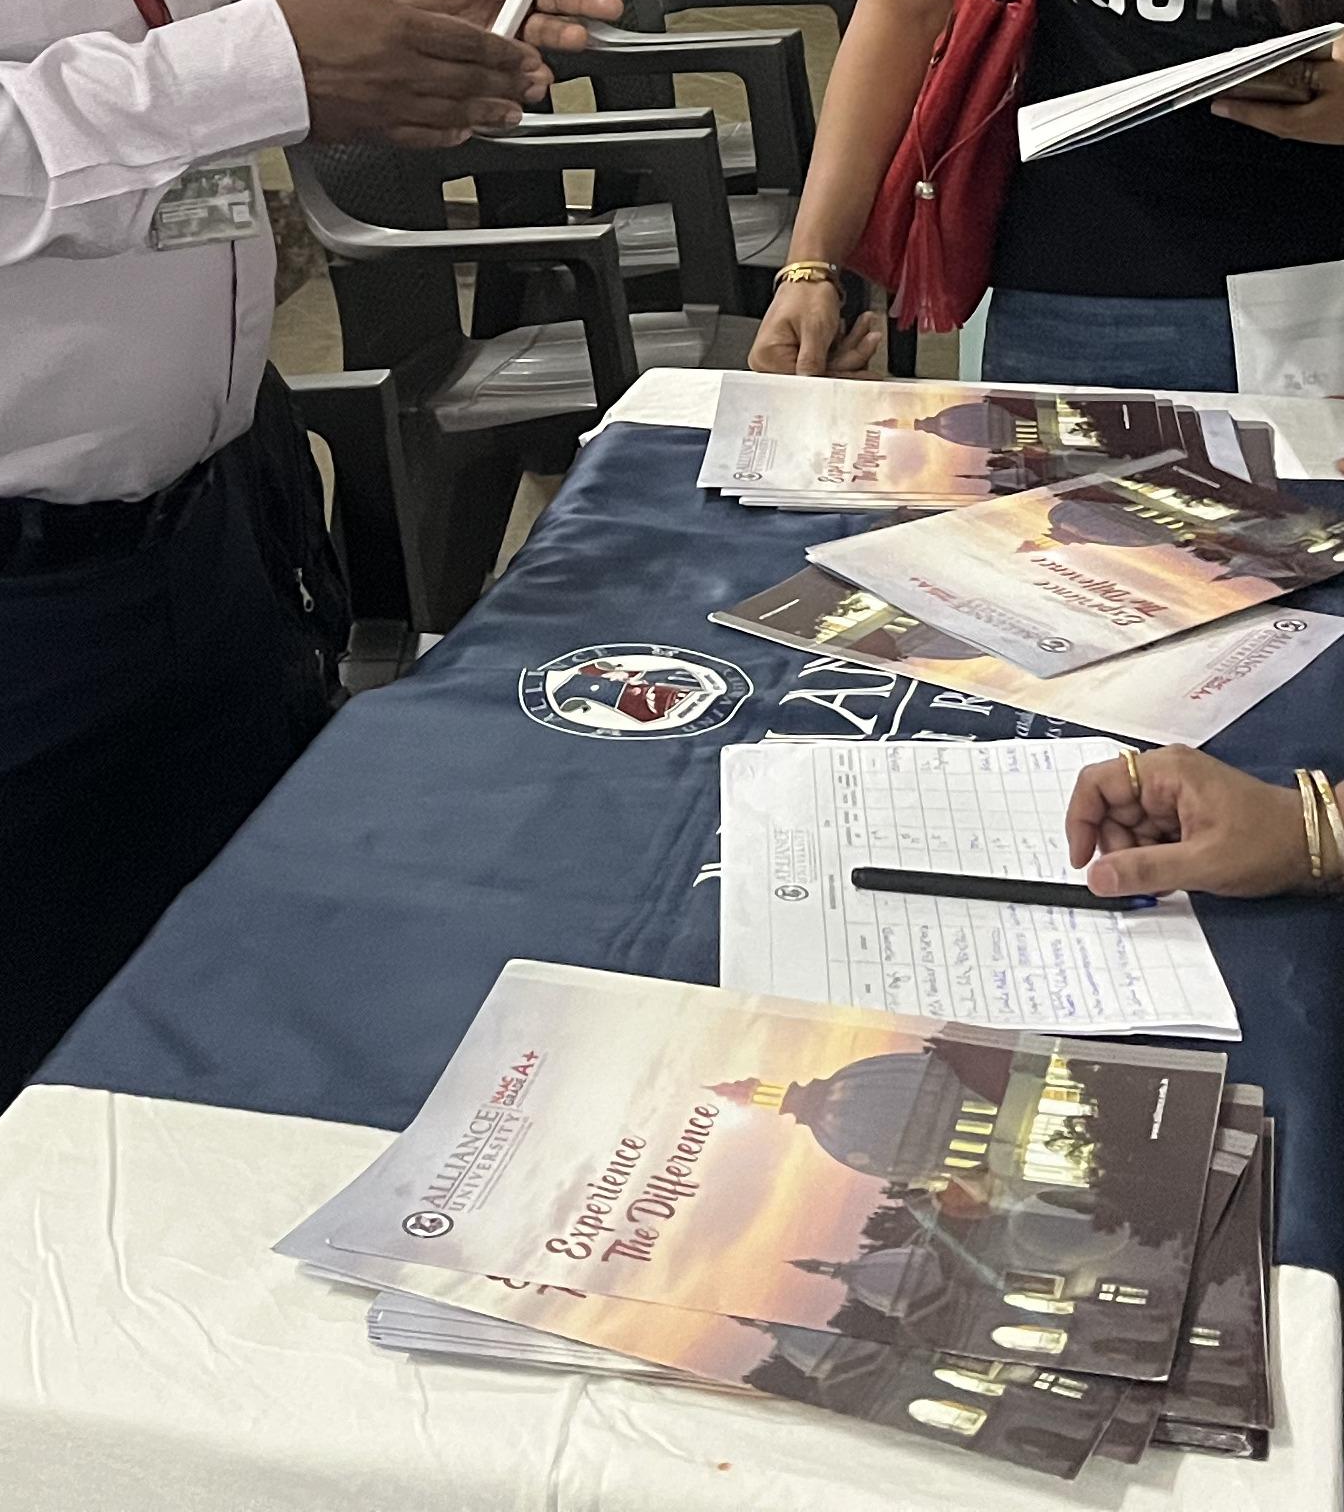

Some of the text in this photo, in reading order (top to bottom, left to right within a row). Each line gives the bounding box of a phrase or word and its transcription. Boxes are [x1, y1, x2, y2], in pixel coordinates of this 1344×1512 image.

[420, 1108, 501, 1209] ALLIANCE
[448, 1110, 521, 1212] UNIVERSITY
[545, 1134, 648, 1260] Experience
[601, 1102, 720, 1262] The Difference
